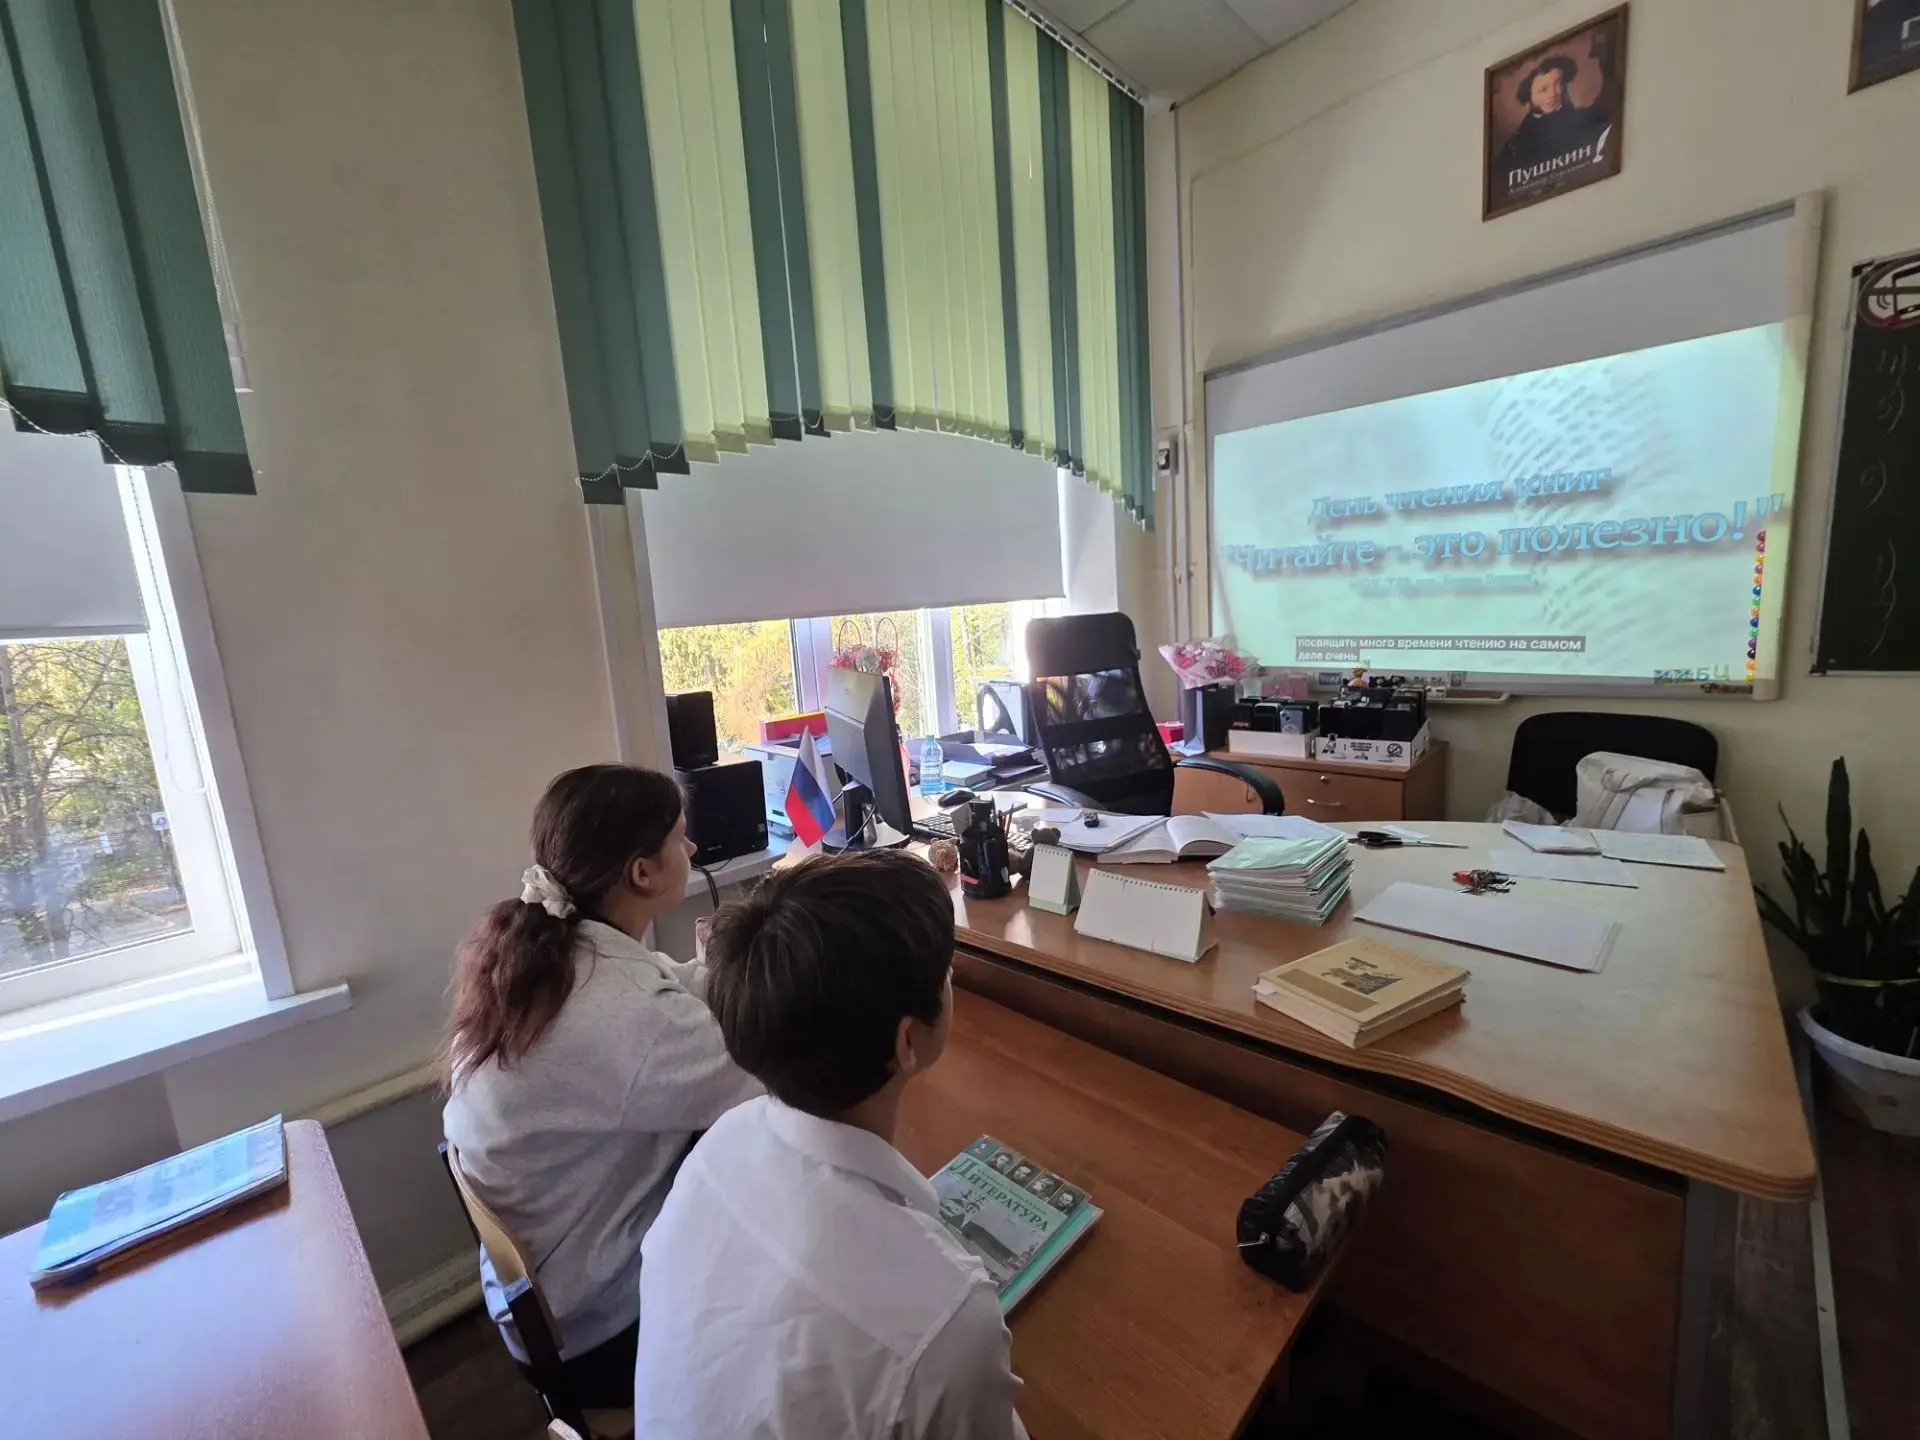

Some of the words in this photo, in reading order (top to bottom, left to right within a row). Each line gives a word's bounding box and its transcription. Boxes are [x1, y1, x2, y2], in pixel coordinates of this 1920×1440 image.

[1508, 144, 1591, 187] Пушкин
[1307, 496, 1379, 525] День
[1385, 480, 1506, 511] чтения
[1514, 467, 1612, 500] книг
[1413, 530, 1487, 559] это
[1297, 638, 1357, 649] посвящать
[1359, 638, 1394, 649] много
[1397, 639, 1452, 651] времени
[1455, 638, 1506, 649] чтению
[1509, 639, 1527, 650] на
[1530, 639, 1582, 650] самом
[1325, 651, 1357, 661] очень
